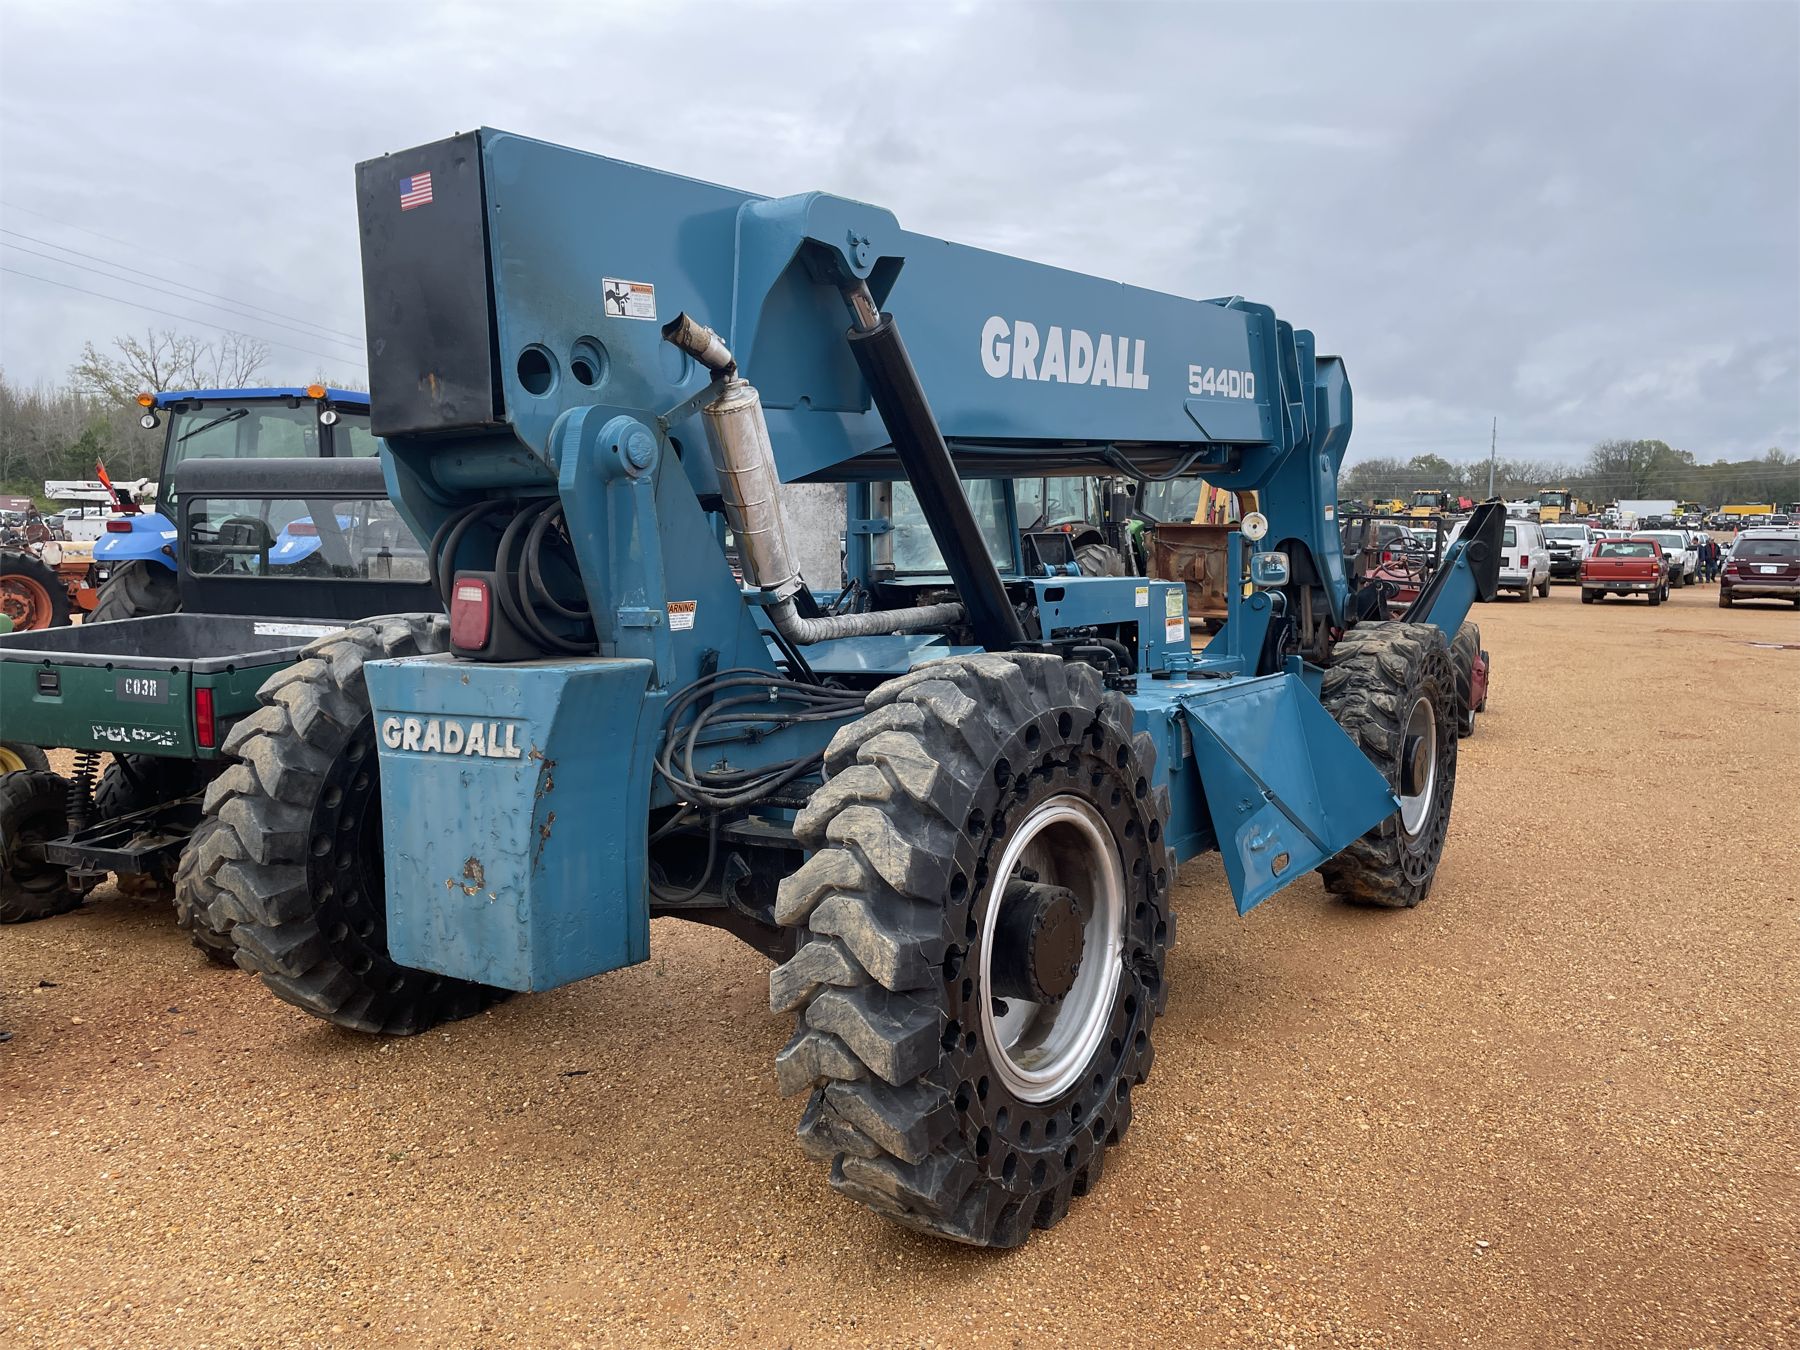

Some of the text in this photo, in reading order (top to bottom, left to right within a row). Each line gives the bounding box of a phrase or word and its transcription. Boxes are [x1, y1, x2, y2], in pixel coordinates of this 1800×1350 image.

[980, 316, 1149, 390] GRADALL
[668, 603, 694, 613] ARNING
[382, 717, 522, 758] GRADALL
